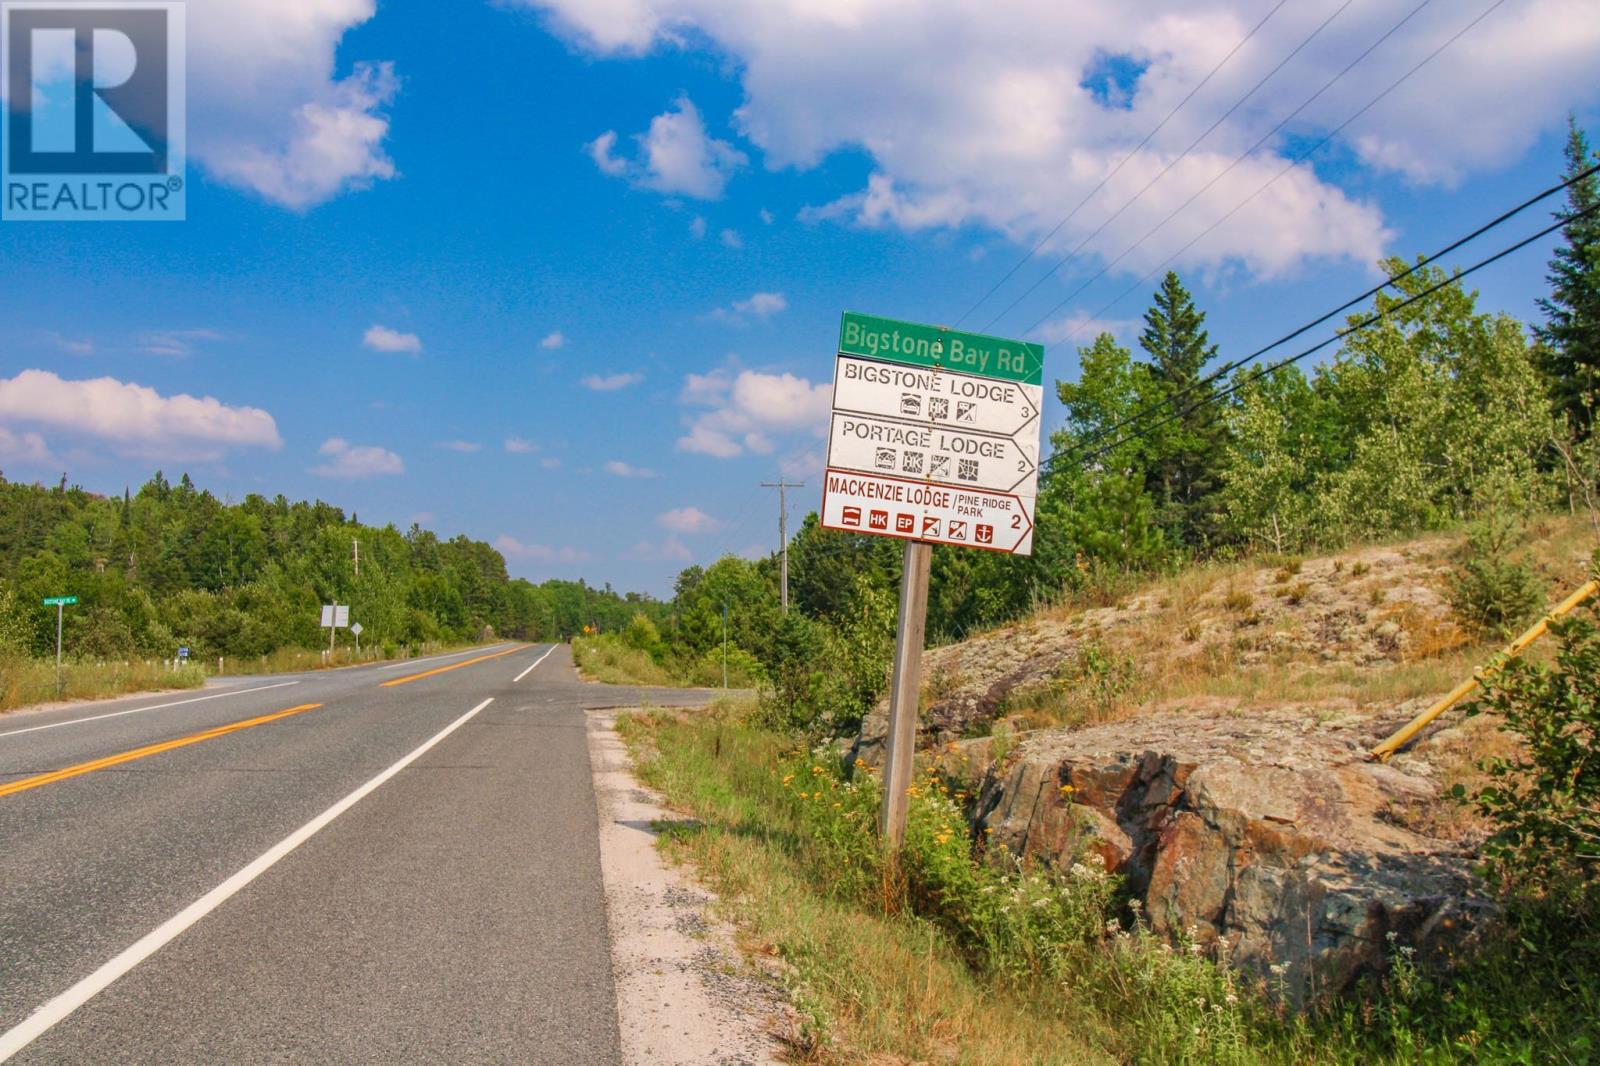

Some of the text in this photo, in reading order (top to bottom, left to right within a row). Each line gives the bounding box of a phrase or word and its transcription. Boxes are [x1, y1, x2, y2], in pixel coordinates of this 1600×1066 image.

[844, 321, 1029, 374] Bigstone Bay Rd.
[845, 363, 1016, 404] BIGSTONE LODGE
[1021, 406, 1030, 418] 3
[843, 421, 1006, 459] PORTAGE LODGE
[1017, 461, 1026, 472] 2
[829, 477, 904, 502] MACKENZIE
[907, 488, 950, 508] LODGE
[982, 497, 1012, 510] RIDGE
[957, 505, 984, 518] PARK
[870, 513, 912, 529] HK EP
[1011, 515, 1021, 529] 2
